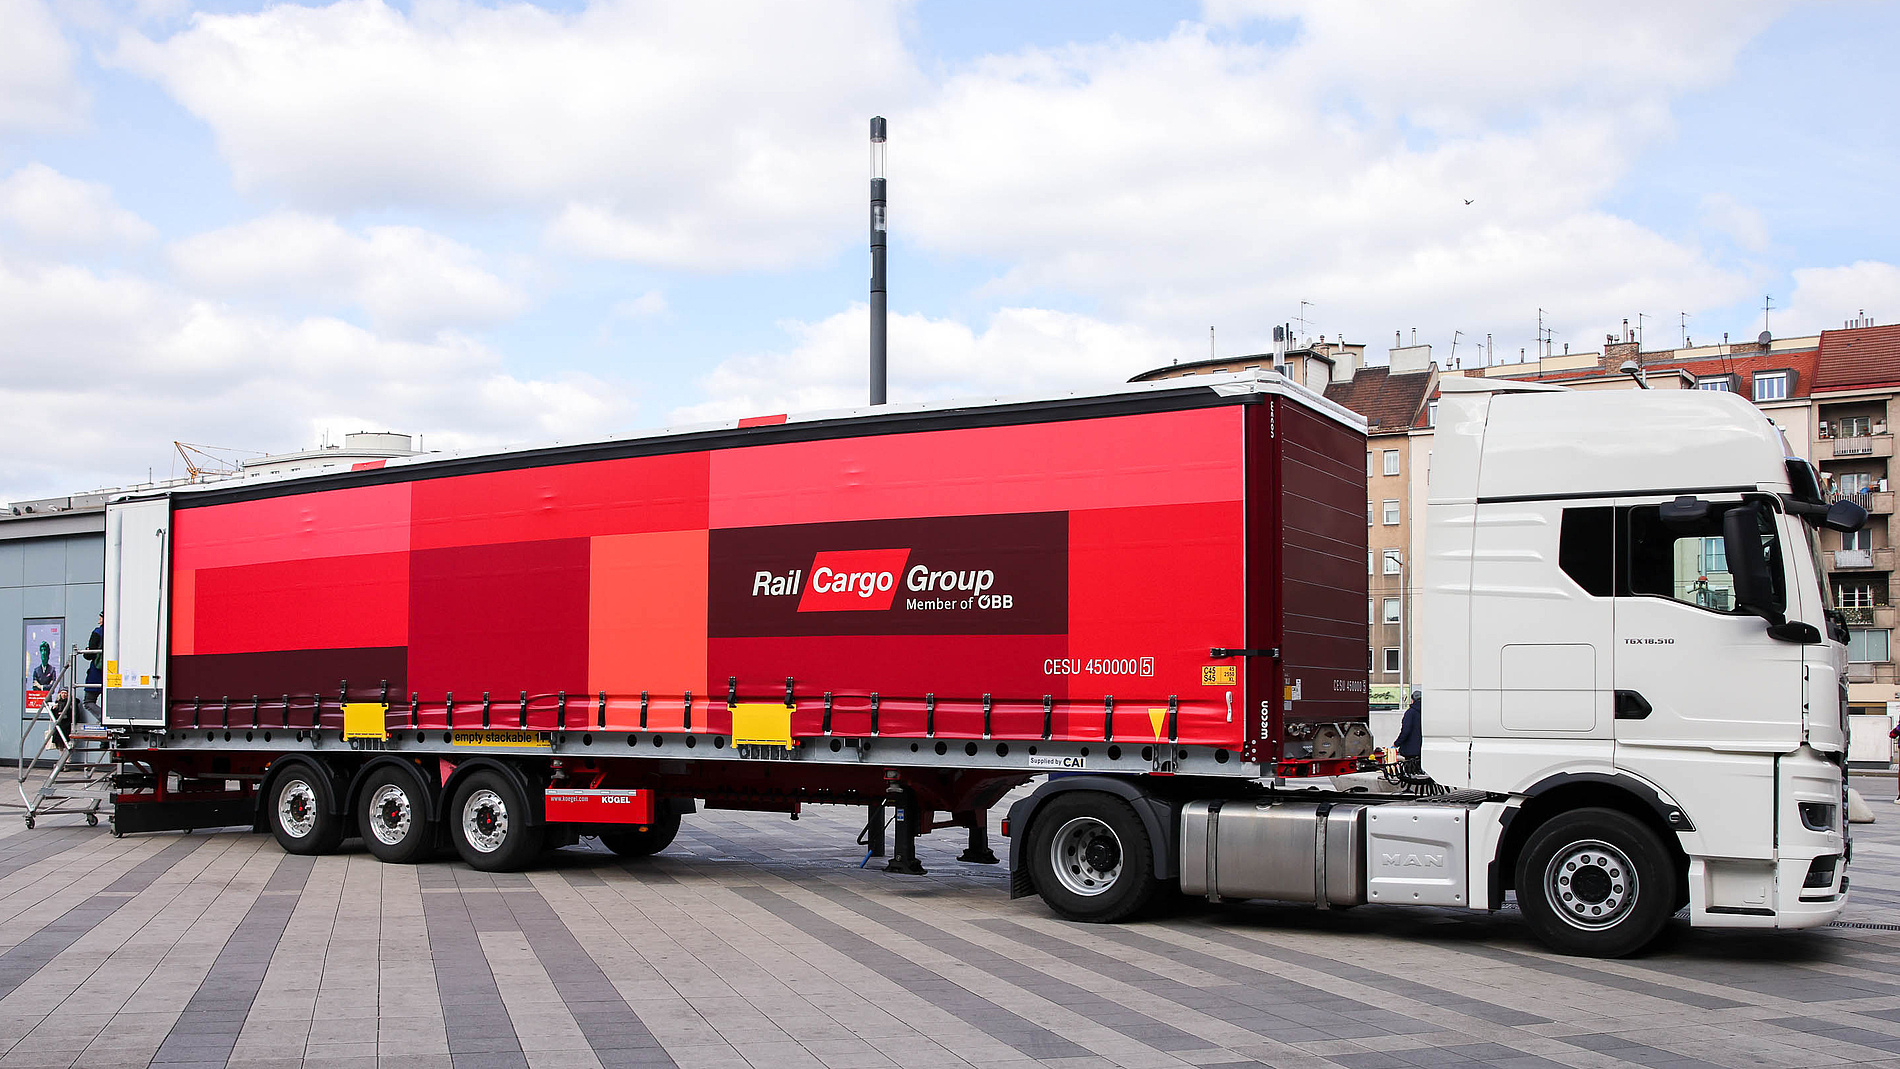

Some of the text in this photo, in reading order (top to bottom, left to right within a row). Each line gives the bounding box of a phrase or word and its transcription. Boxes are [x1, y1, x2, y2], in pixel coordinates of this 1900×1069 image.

[752, 565, 994, 598] Rail Cargo Group
[906, 594, 1013, 610] Member of ÖBB
[1043, 658, 1081, 675] CESU
[1085, 658, 1137, 675] 450000
[1204, 666, 1215, 674] C45
[1204, 674, 1215, 682] S45
[1261, 700, 1269, 740] wecon
[455, 732, 483, 744] empty
[485, 732, 532, 743] stackable
[1031, 757, 1084, 767] Supplied by CAI
[601, 795, 631, 804] KÖGEL
[1382, 853, 1443, 867] MAN
